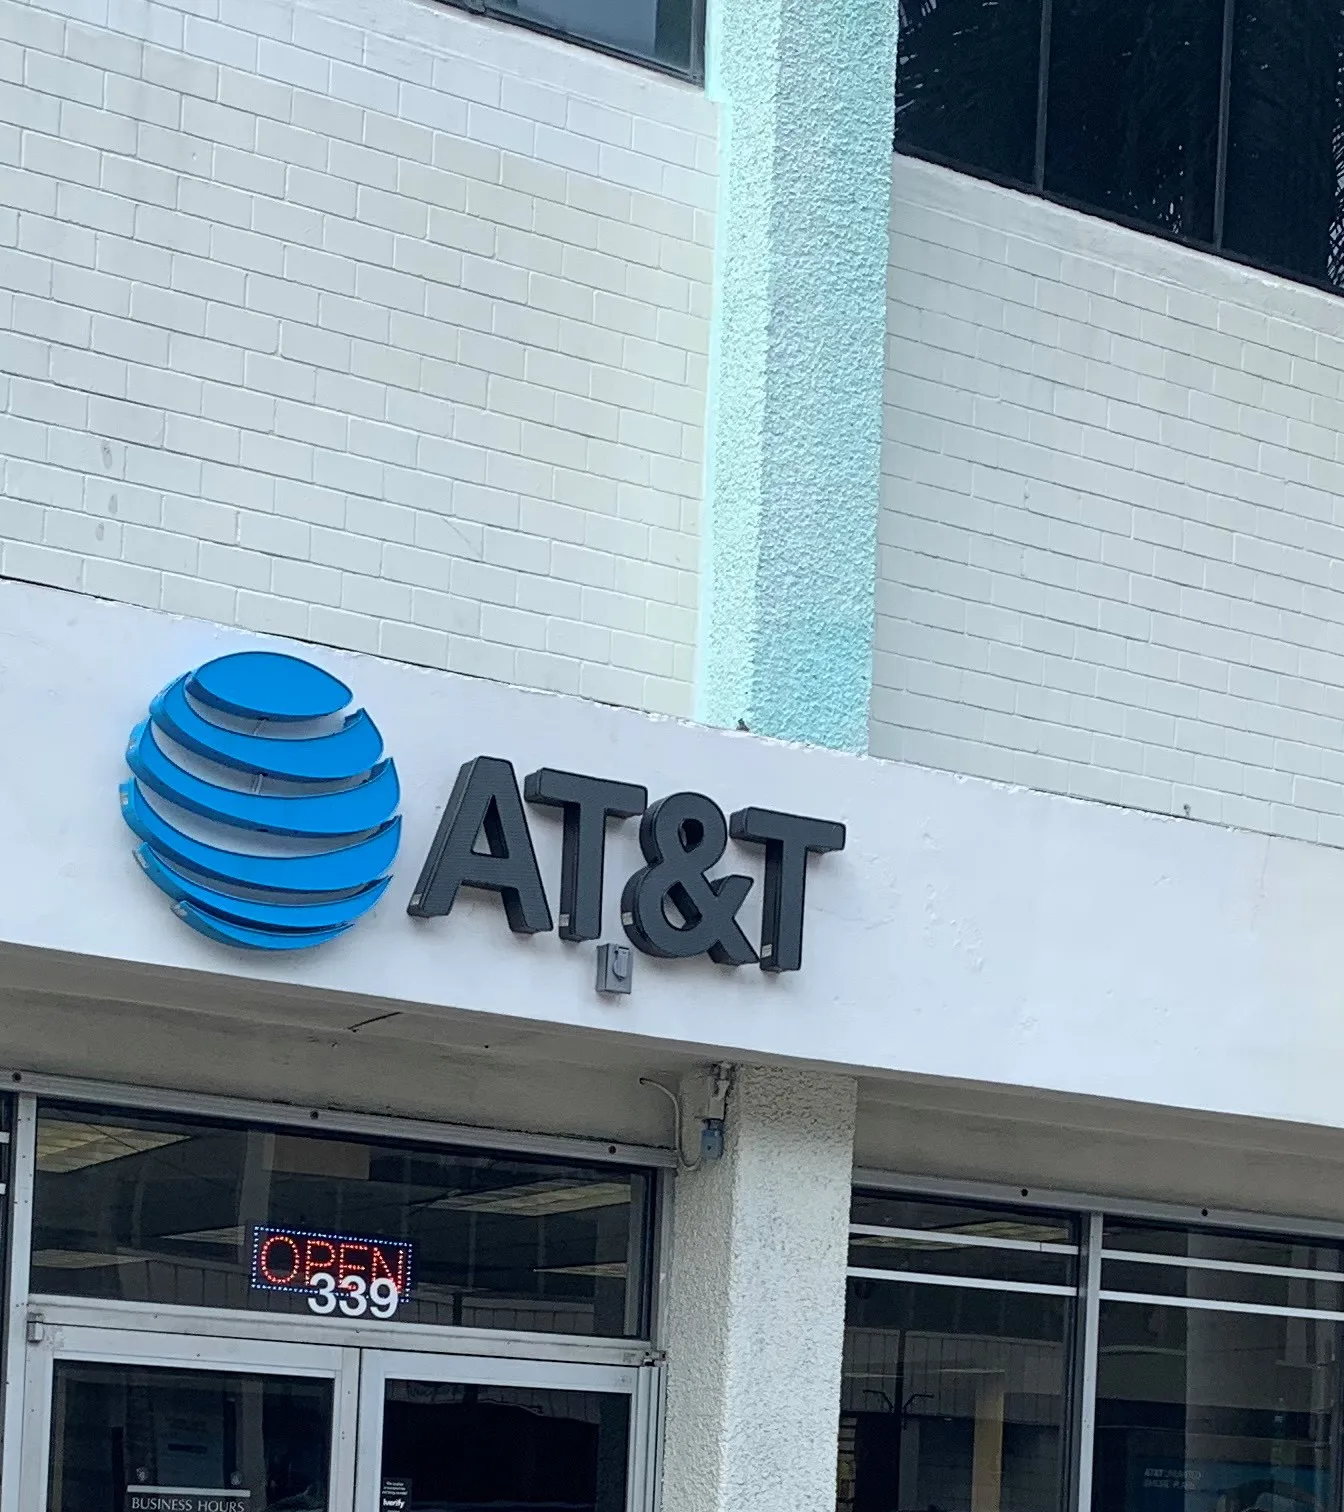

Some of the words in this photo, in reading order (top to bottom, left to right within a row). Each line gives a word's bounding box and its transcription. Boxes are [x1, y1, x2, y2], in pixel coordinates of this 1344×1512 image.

[407, 756, 847, 973] AT&T
[260, 1235, 404, 1295] OPEN
[307, 1271, 399, 1319] 339
[131, 1497, 192, 1512] BUSINESS
[197, 1500, 245, 1512] HOURS
